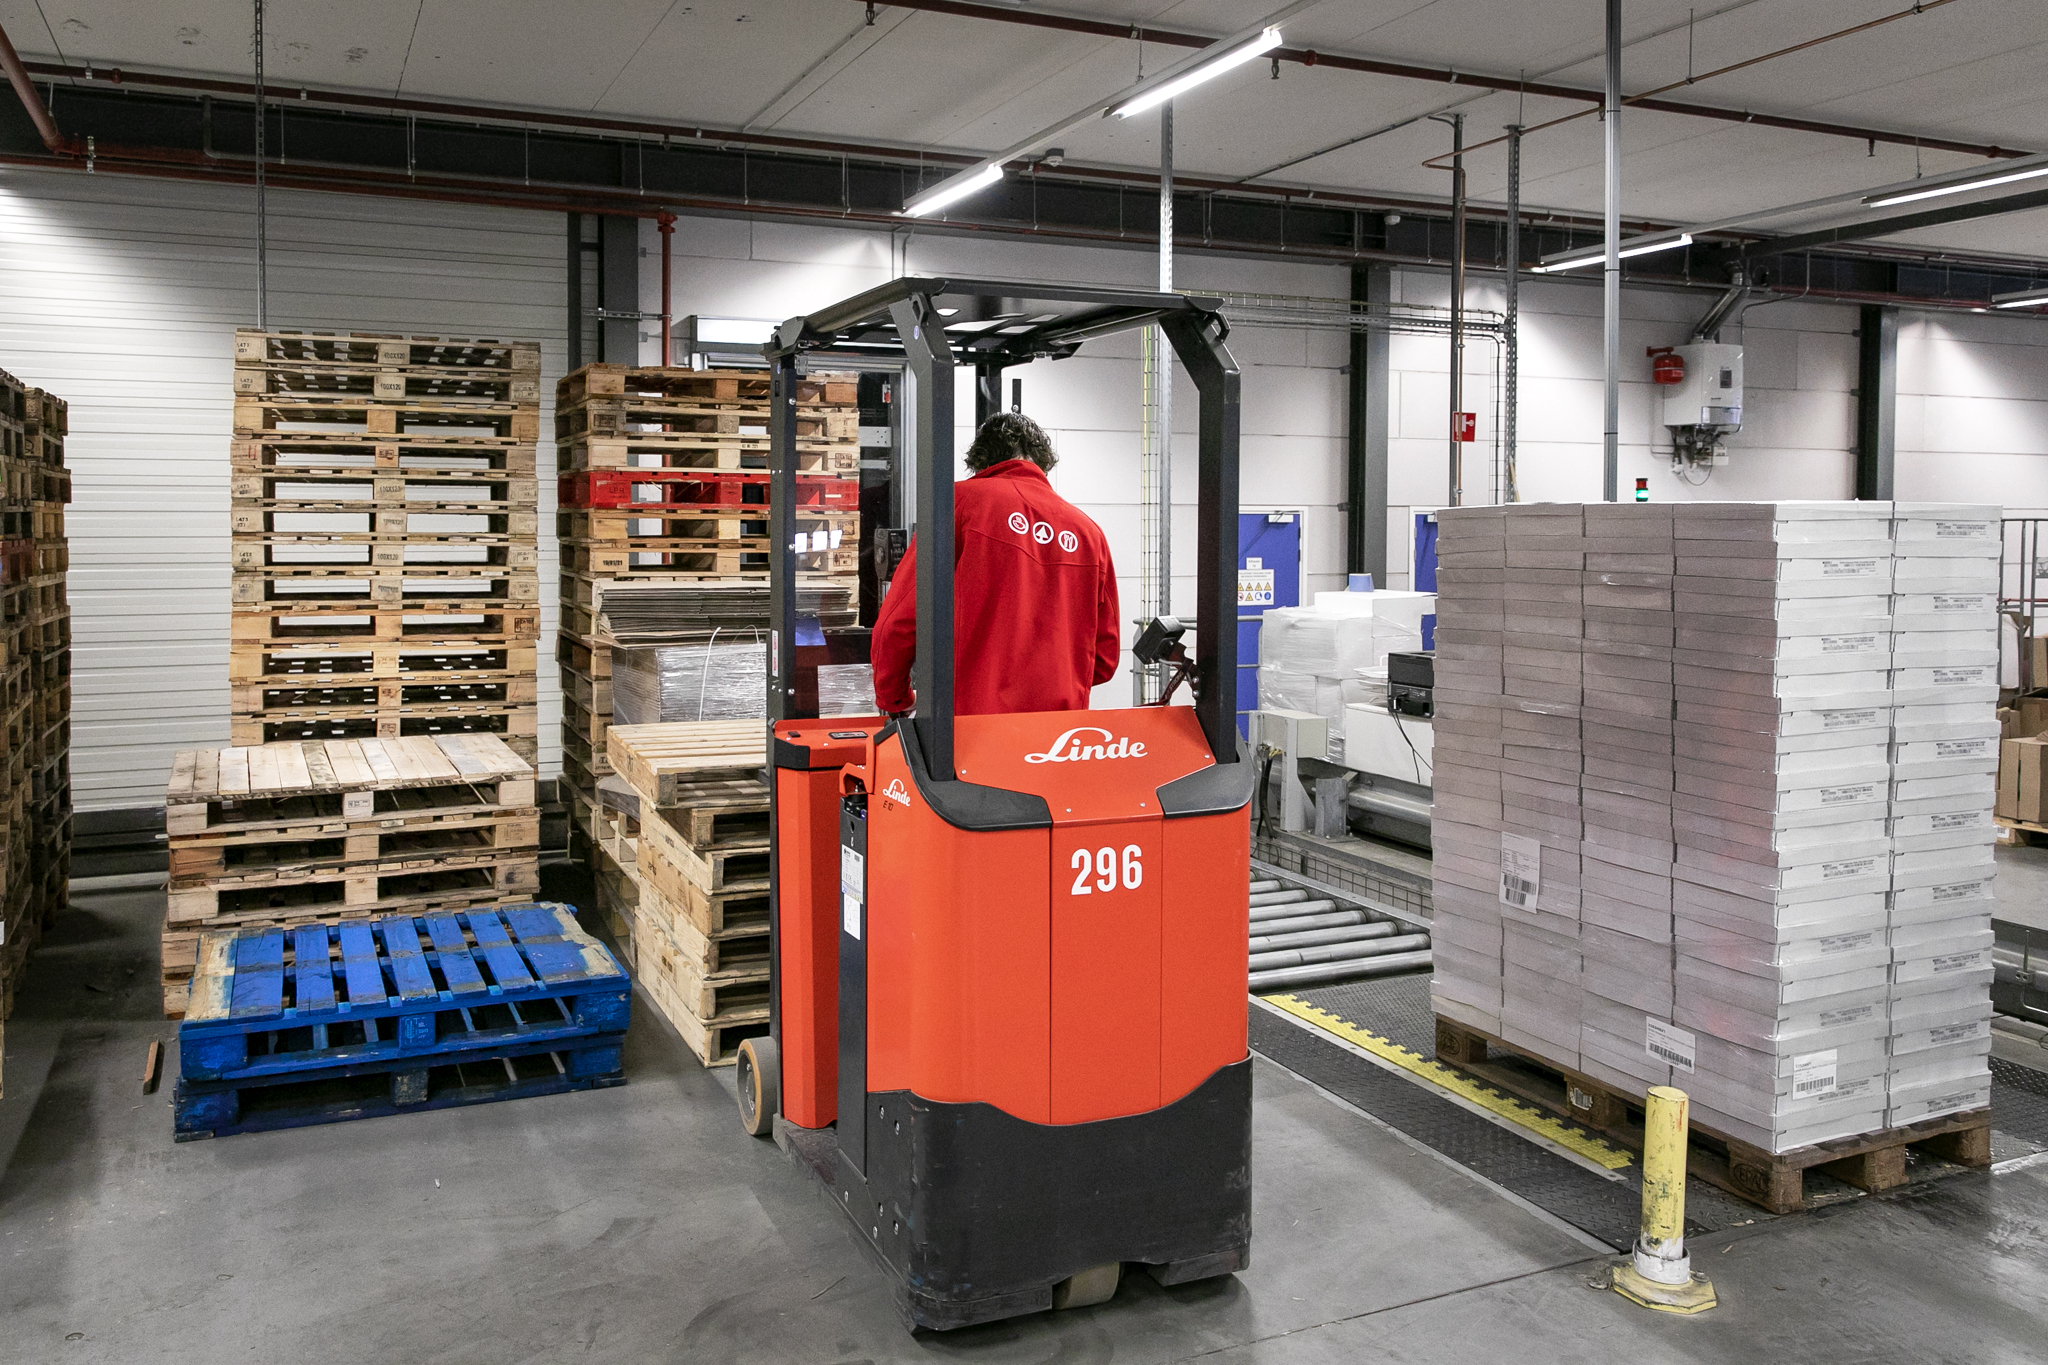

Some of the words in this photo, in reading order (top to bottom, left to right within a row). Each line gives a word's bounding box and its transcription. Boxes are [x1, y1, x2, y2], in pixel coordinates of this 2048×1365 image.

[1024, 727, 1148, 764] Linde
[882, 778, 911, 807] Linde
[1071, 844, 1143, 896] 296
